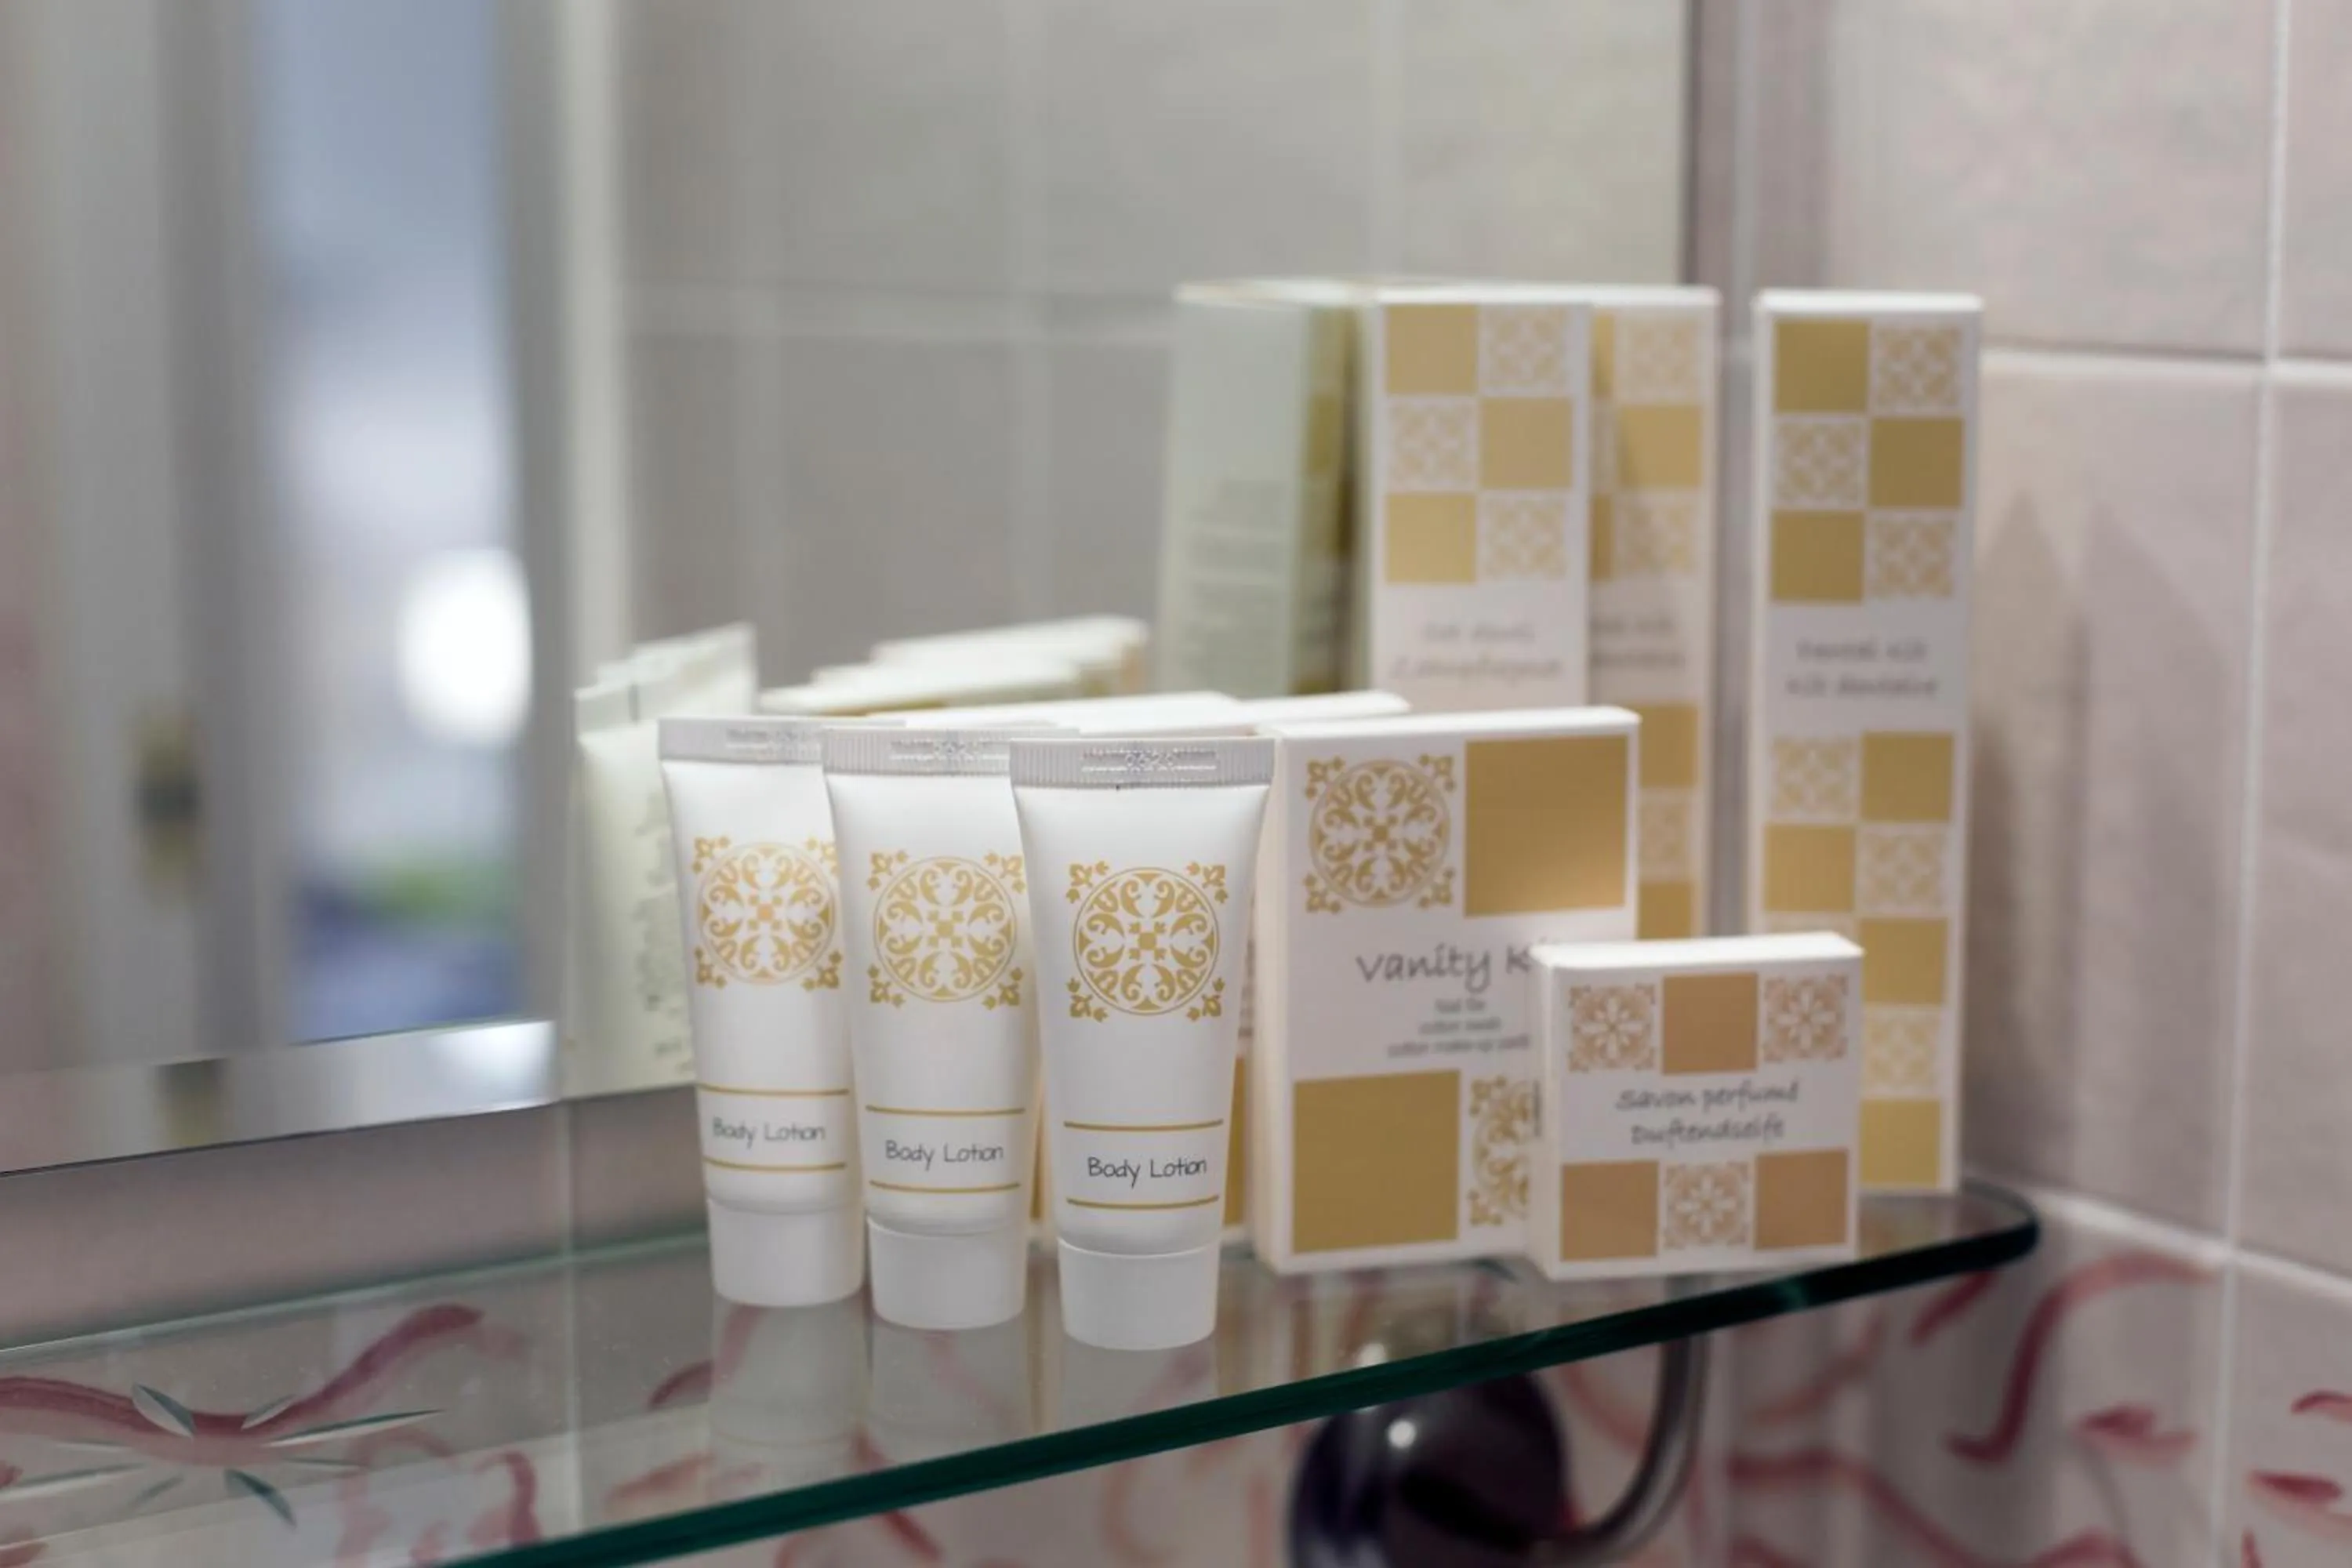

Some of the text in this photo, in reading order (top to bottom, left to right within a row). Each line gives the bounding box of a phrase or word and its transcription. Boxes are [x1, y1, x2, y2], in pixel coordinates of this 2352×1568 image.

[713, 1116, 827, 1150] Body Lotion
[885, 1139, 1004, 1171] Body Lotion
[1087, 1156, 1207, 1189] Body Lotion
